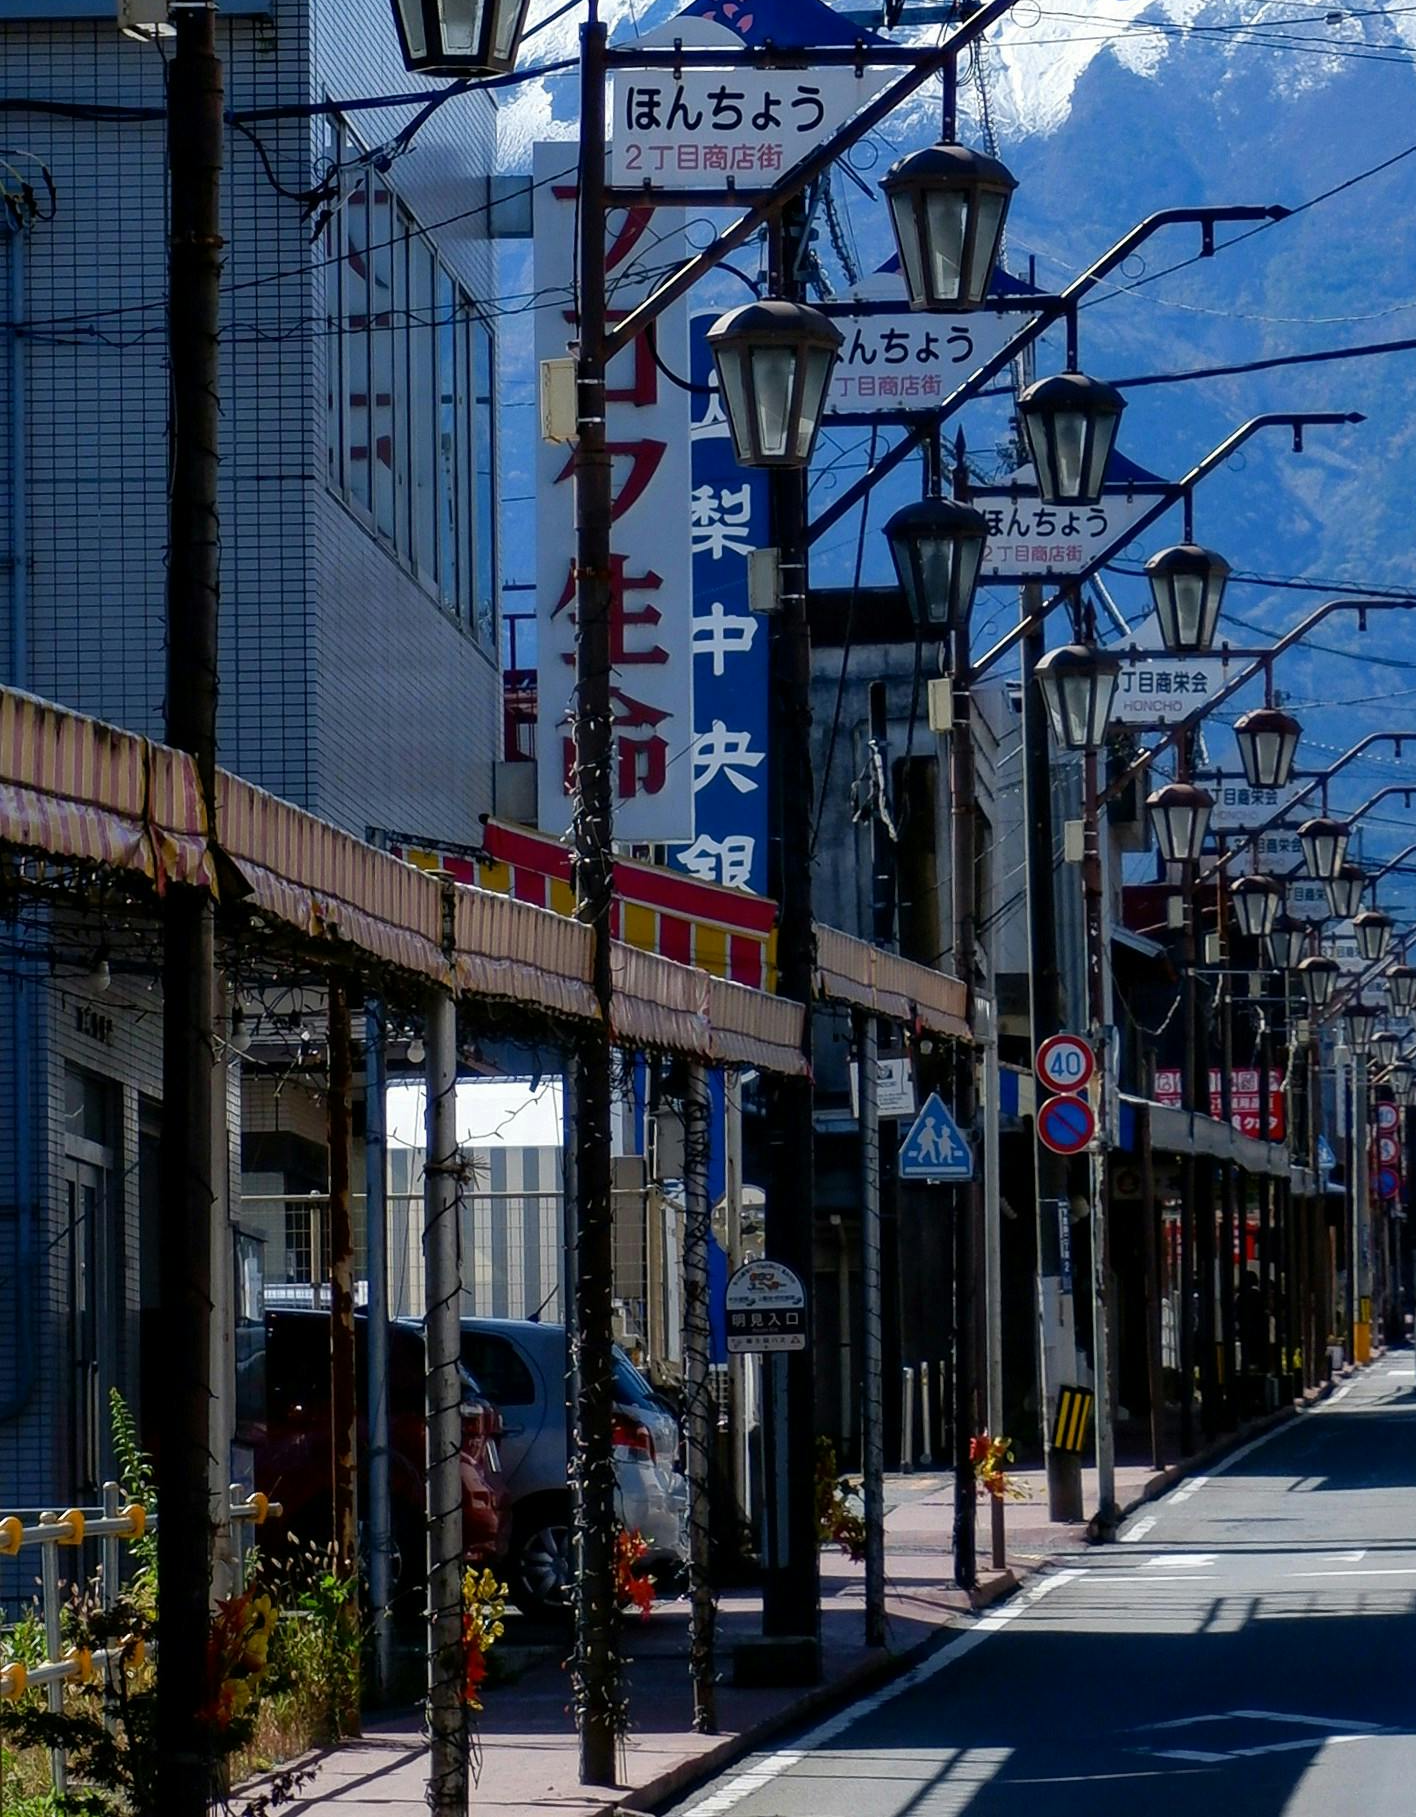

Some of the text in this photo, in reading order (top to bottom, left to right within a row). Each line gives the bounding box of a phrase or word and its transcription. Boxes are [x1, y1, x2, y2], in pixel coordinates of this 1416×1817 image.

[626, 85, 825, 132] ほんちょう
[625, 143, 784, 172] 2丁目商店街
[835, 326, 973, 365] んちょう
[827, 374, 943, 398] 丁目商店街
[982, 507, 1108, 538] ほんちょう
[1116, 670, 1208, 694] 丁目商栄会
[1050, 1051, 1081, 1077] 40
[731, 1312, 799, 1327] 明見入口
